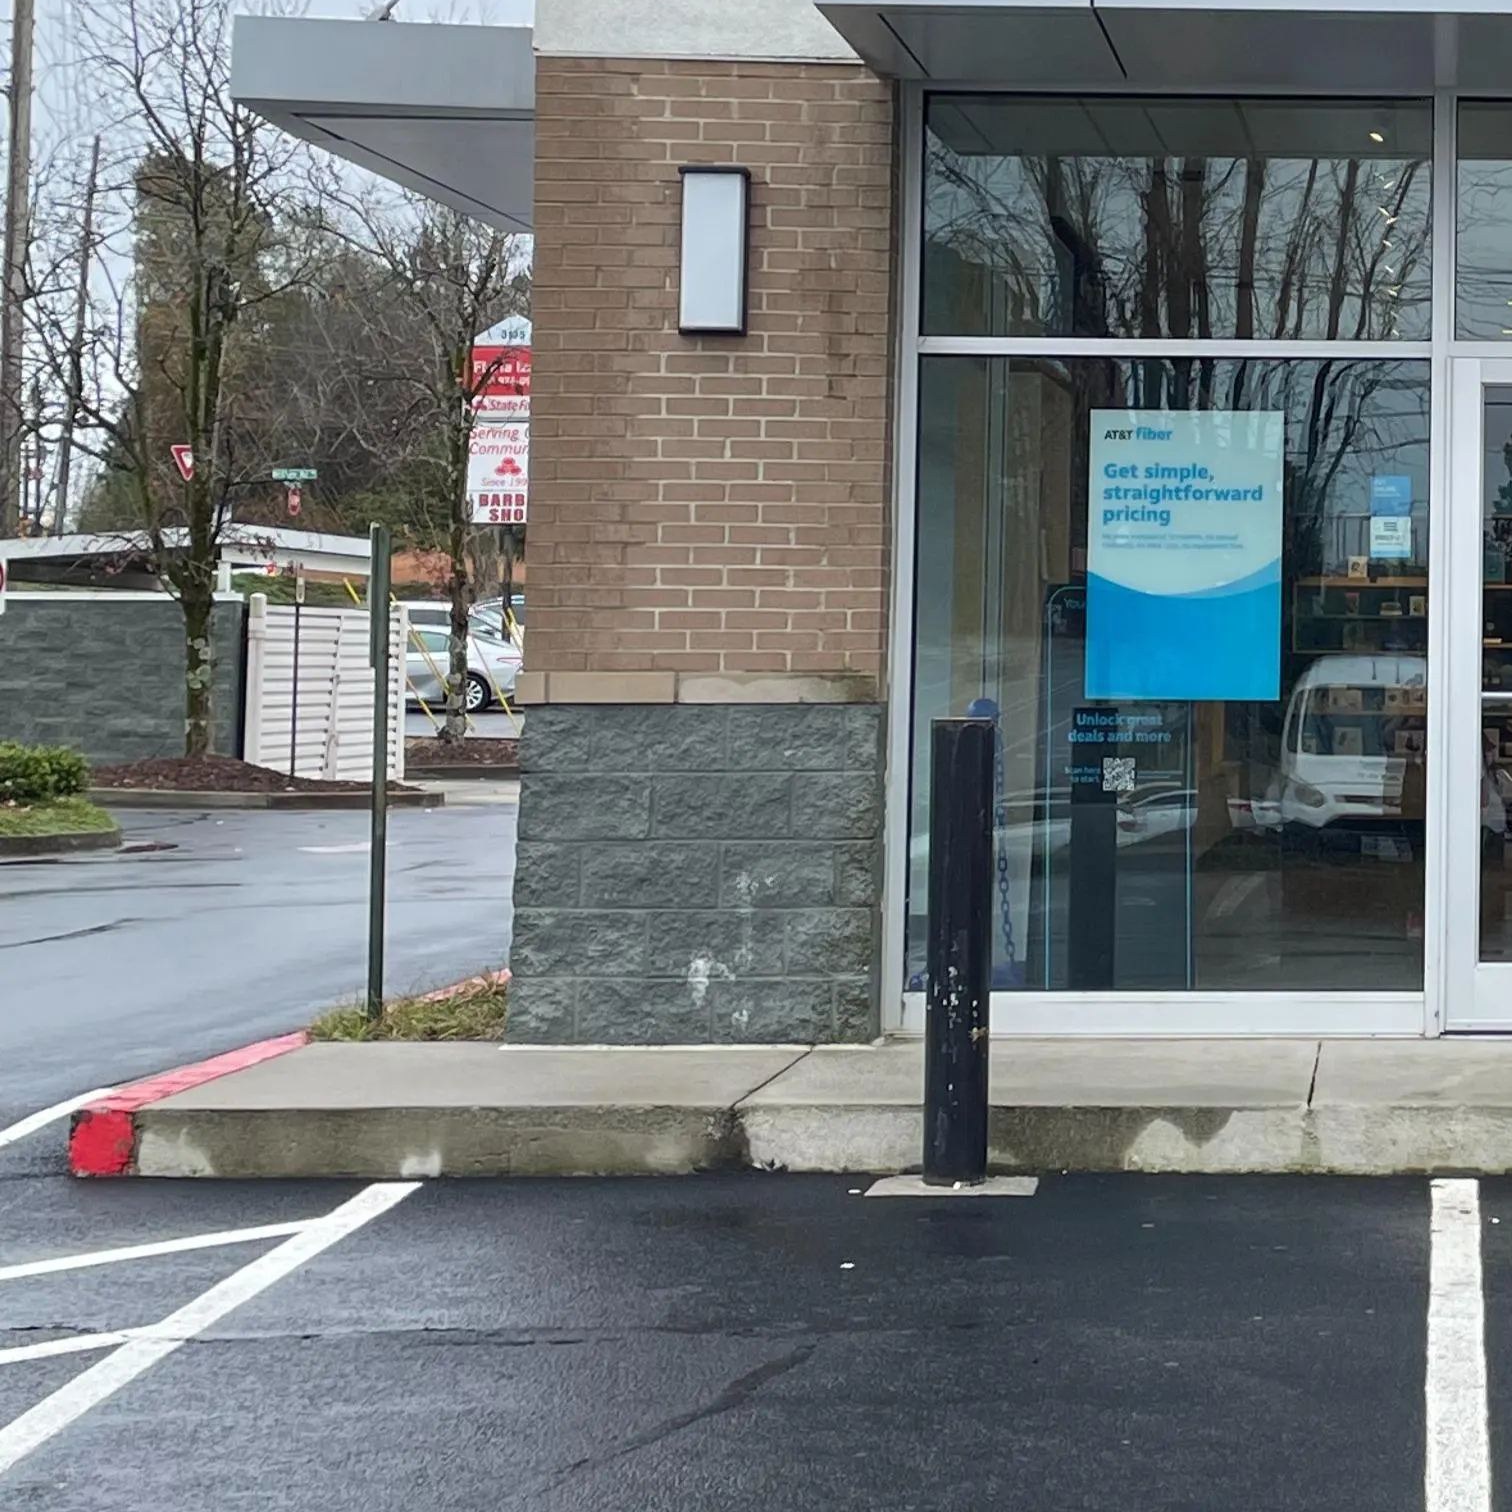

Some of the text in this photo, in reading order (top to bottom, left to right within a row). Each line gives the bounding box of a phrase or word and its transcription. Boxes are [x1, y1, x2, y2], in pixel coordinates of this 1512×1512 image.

[469, 428, 520, 442] Serving
[1104, 426, 1173, 440] AT&T fiber
[1104, 463, 1214, 483] Get simple,
[479, 493, 525, 507] BARB
[1103, 485, 1263, 504] straightforward
[1103, 506, 1171, 526] pricing
[1076, 713, 1163, 730] Unlock great
[1068, 729, 1172, 743] deals and more
